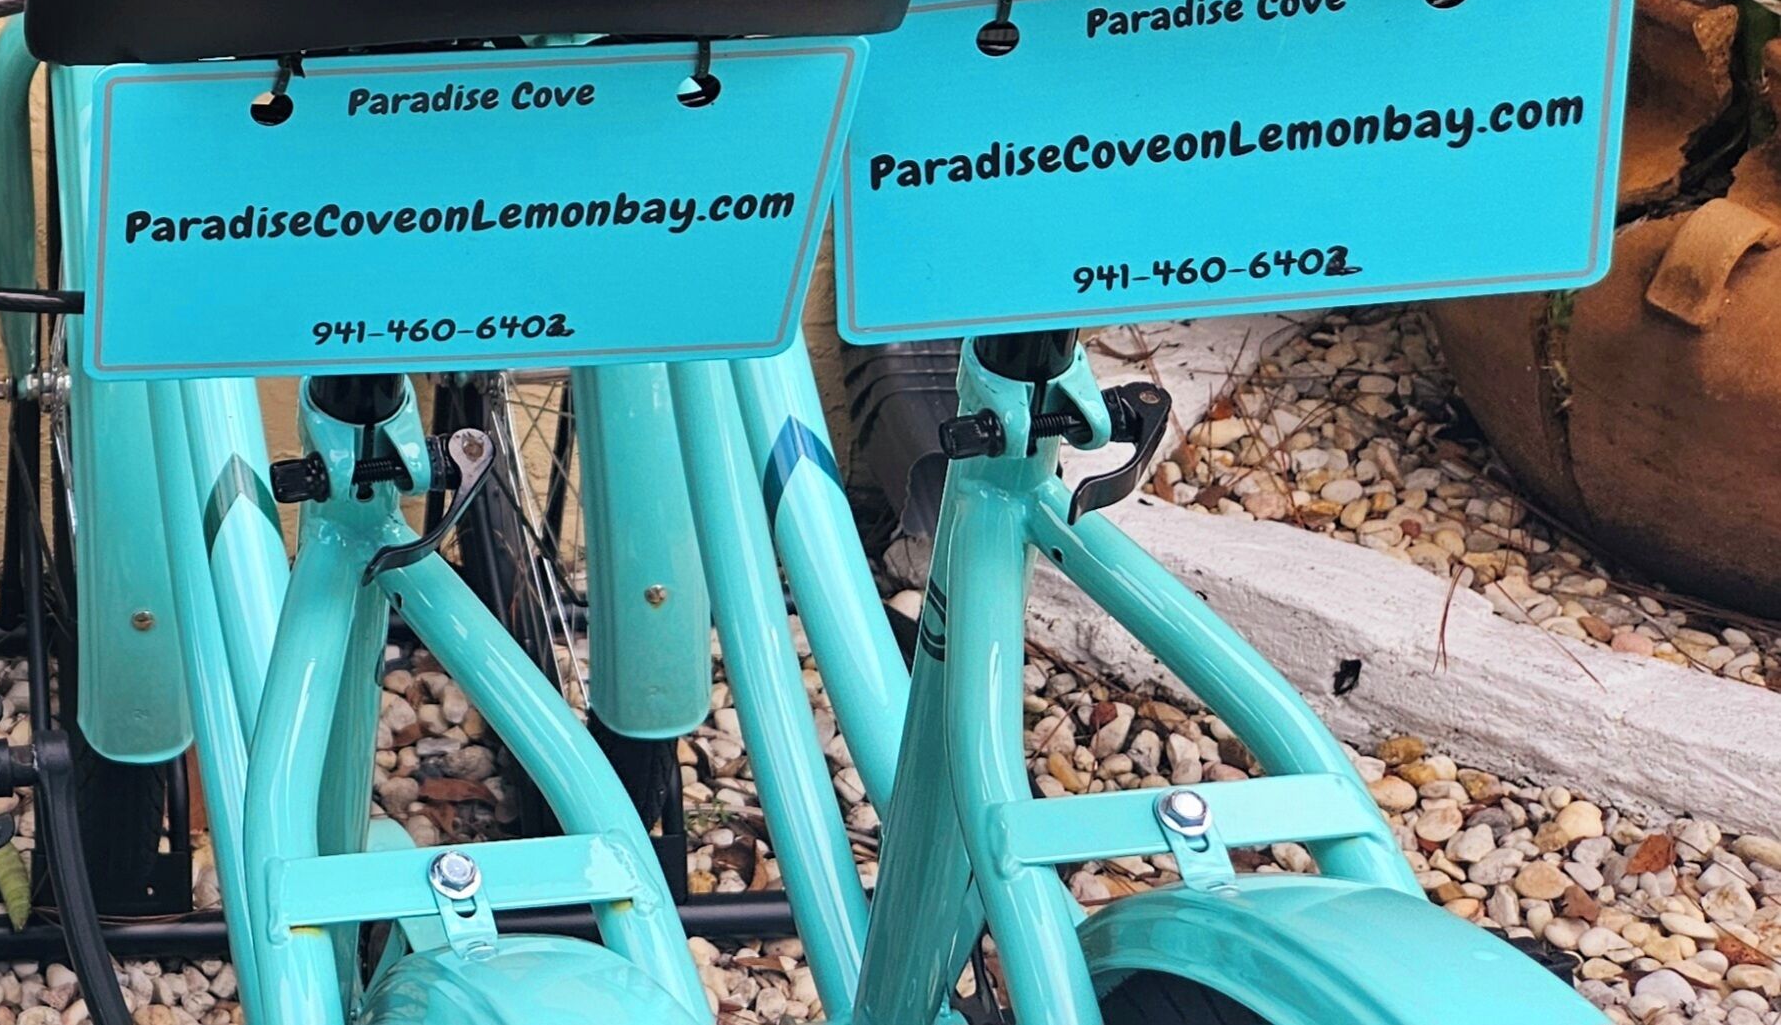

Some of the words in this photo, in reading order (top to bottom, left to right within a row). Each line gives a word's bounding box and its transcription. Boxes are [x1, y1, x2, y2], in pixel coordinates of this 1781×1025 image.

[348, 84, 498, 115] Paradise
[512, 82, 594, 109] Cove
[871, 97, 1583, 190] ParadiseCoveonLemonbay.com
[126, 193, 794, 243] ParadiseCoveonLemonbay.com
